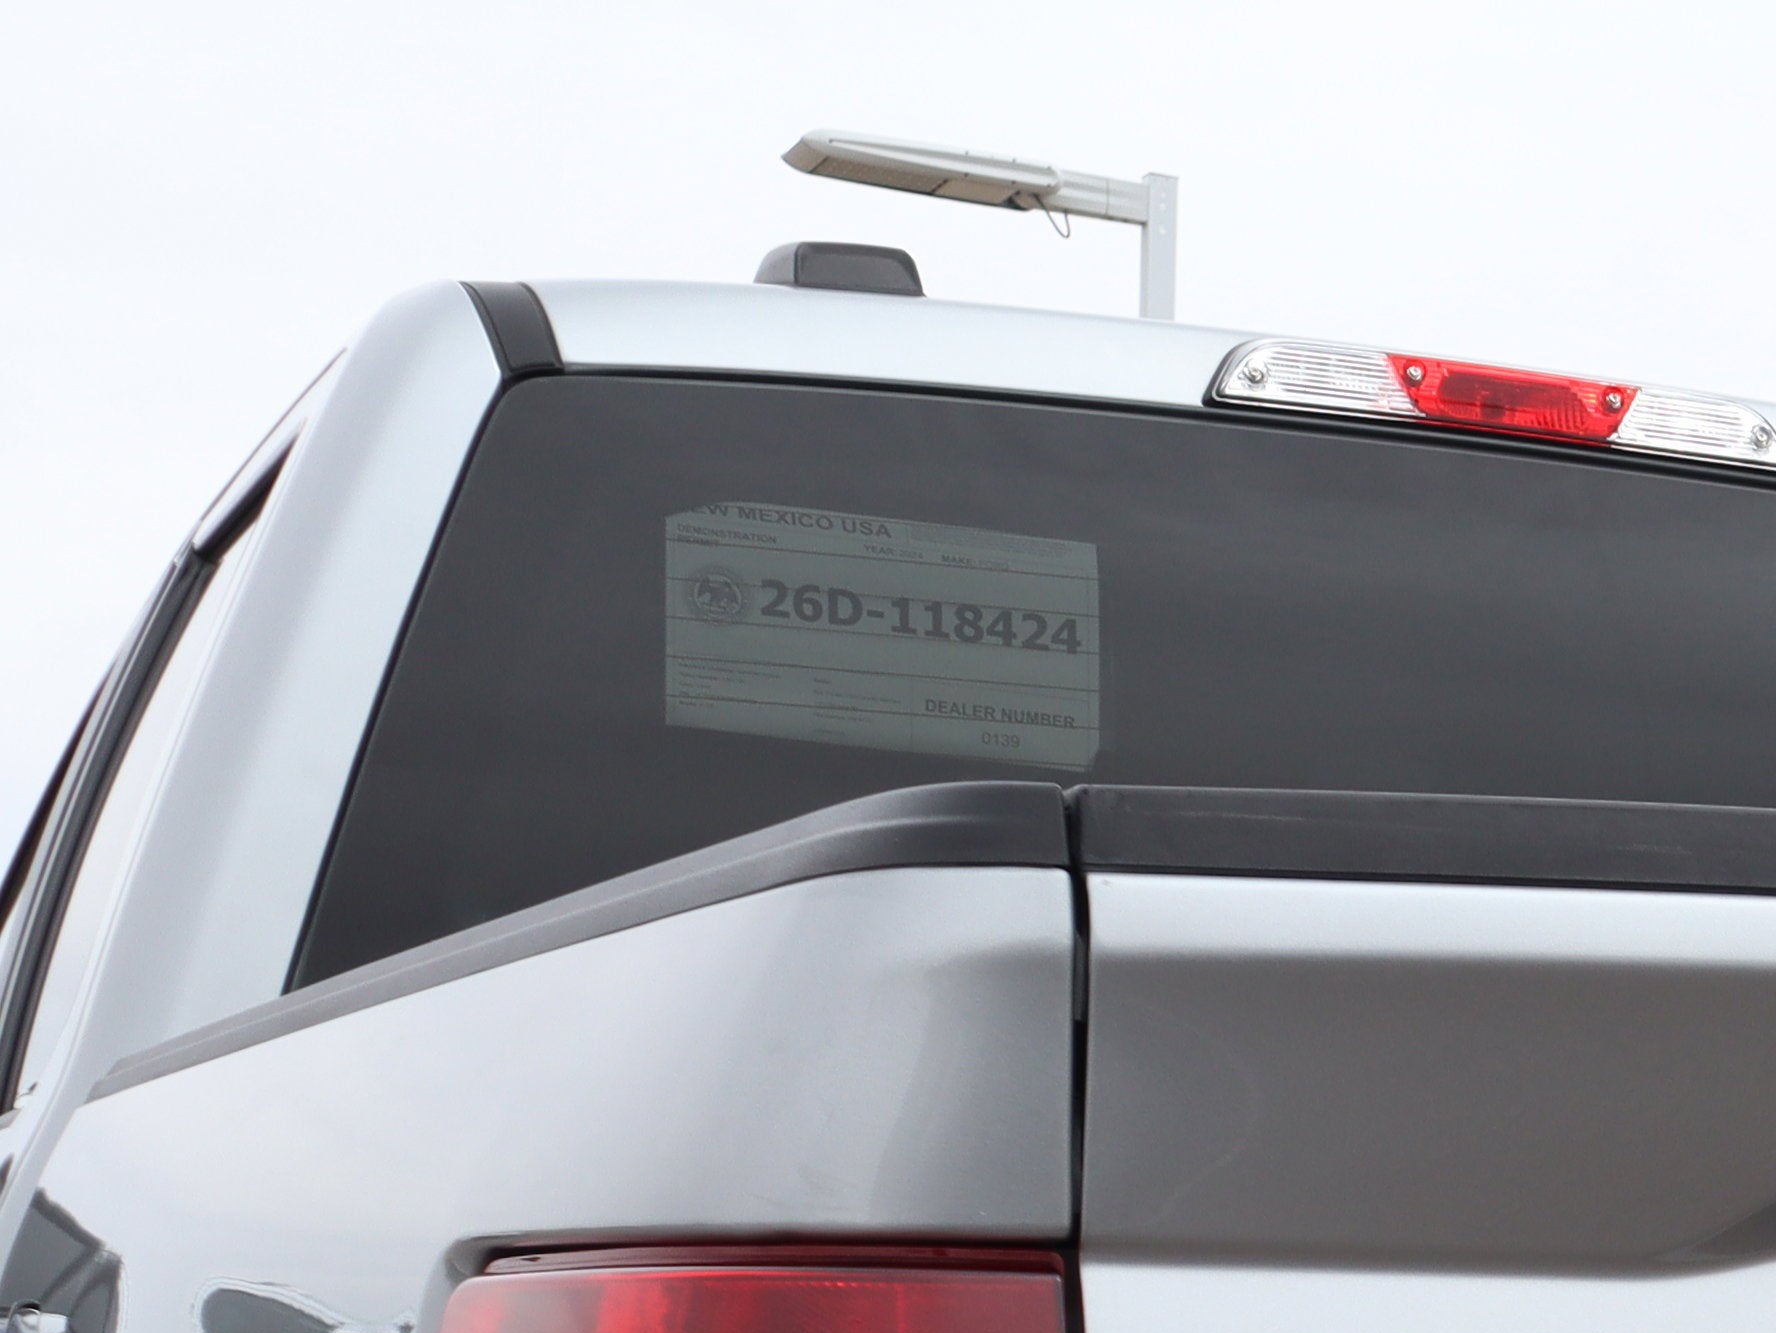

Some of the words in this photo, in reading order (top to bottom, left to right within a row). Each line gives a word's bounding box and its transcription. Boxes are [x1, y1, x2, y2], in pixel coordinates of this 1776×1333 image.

[677, 523, 777, 545] DEMONSTRATION
[736, 506, 833, 531] MEXICO
[841, 518, 893, 539] USA
[760, 578, 1081, 654] 26D-118424
[925, 699, 996, 721] DEALER
[1001, 707, 1076, 729] NUMBER
[981, 731, 1021, 749] 0139
